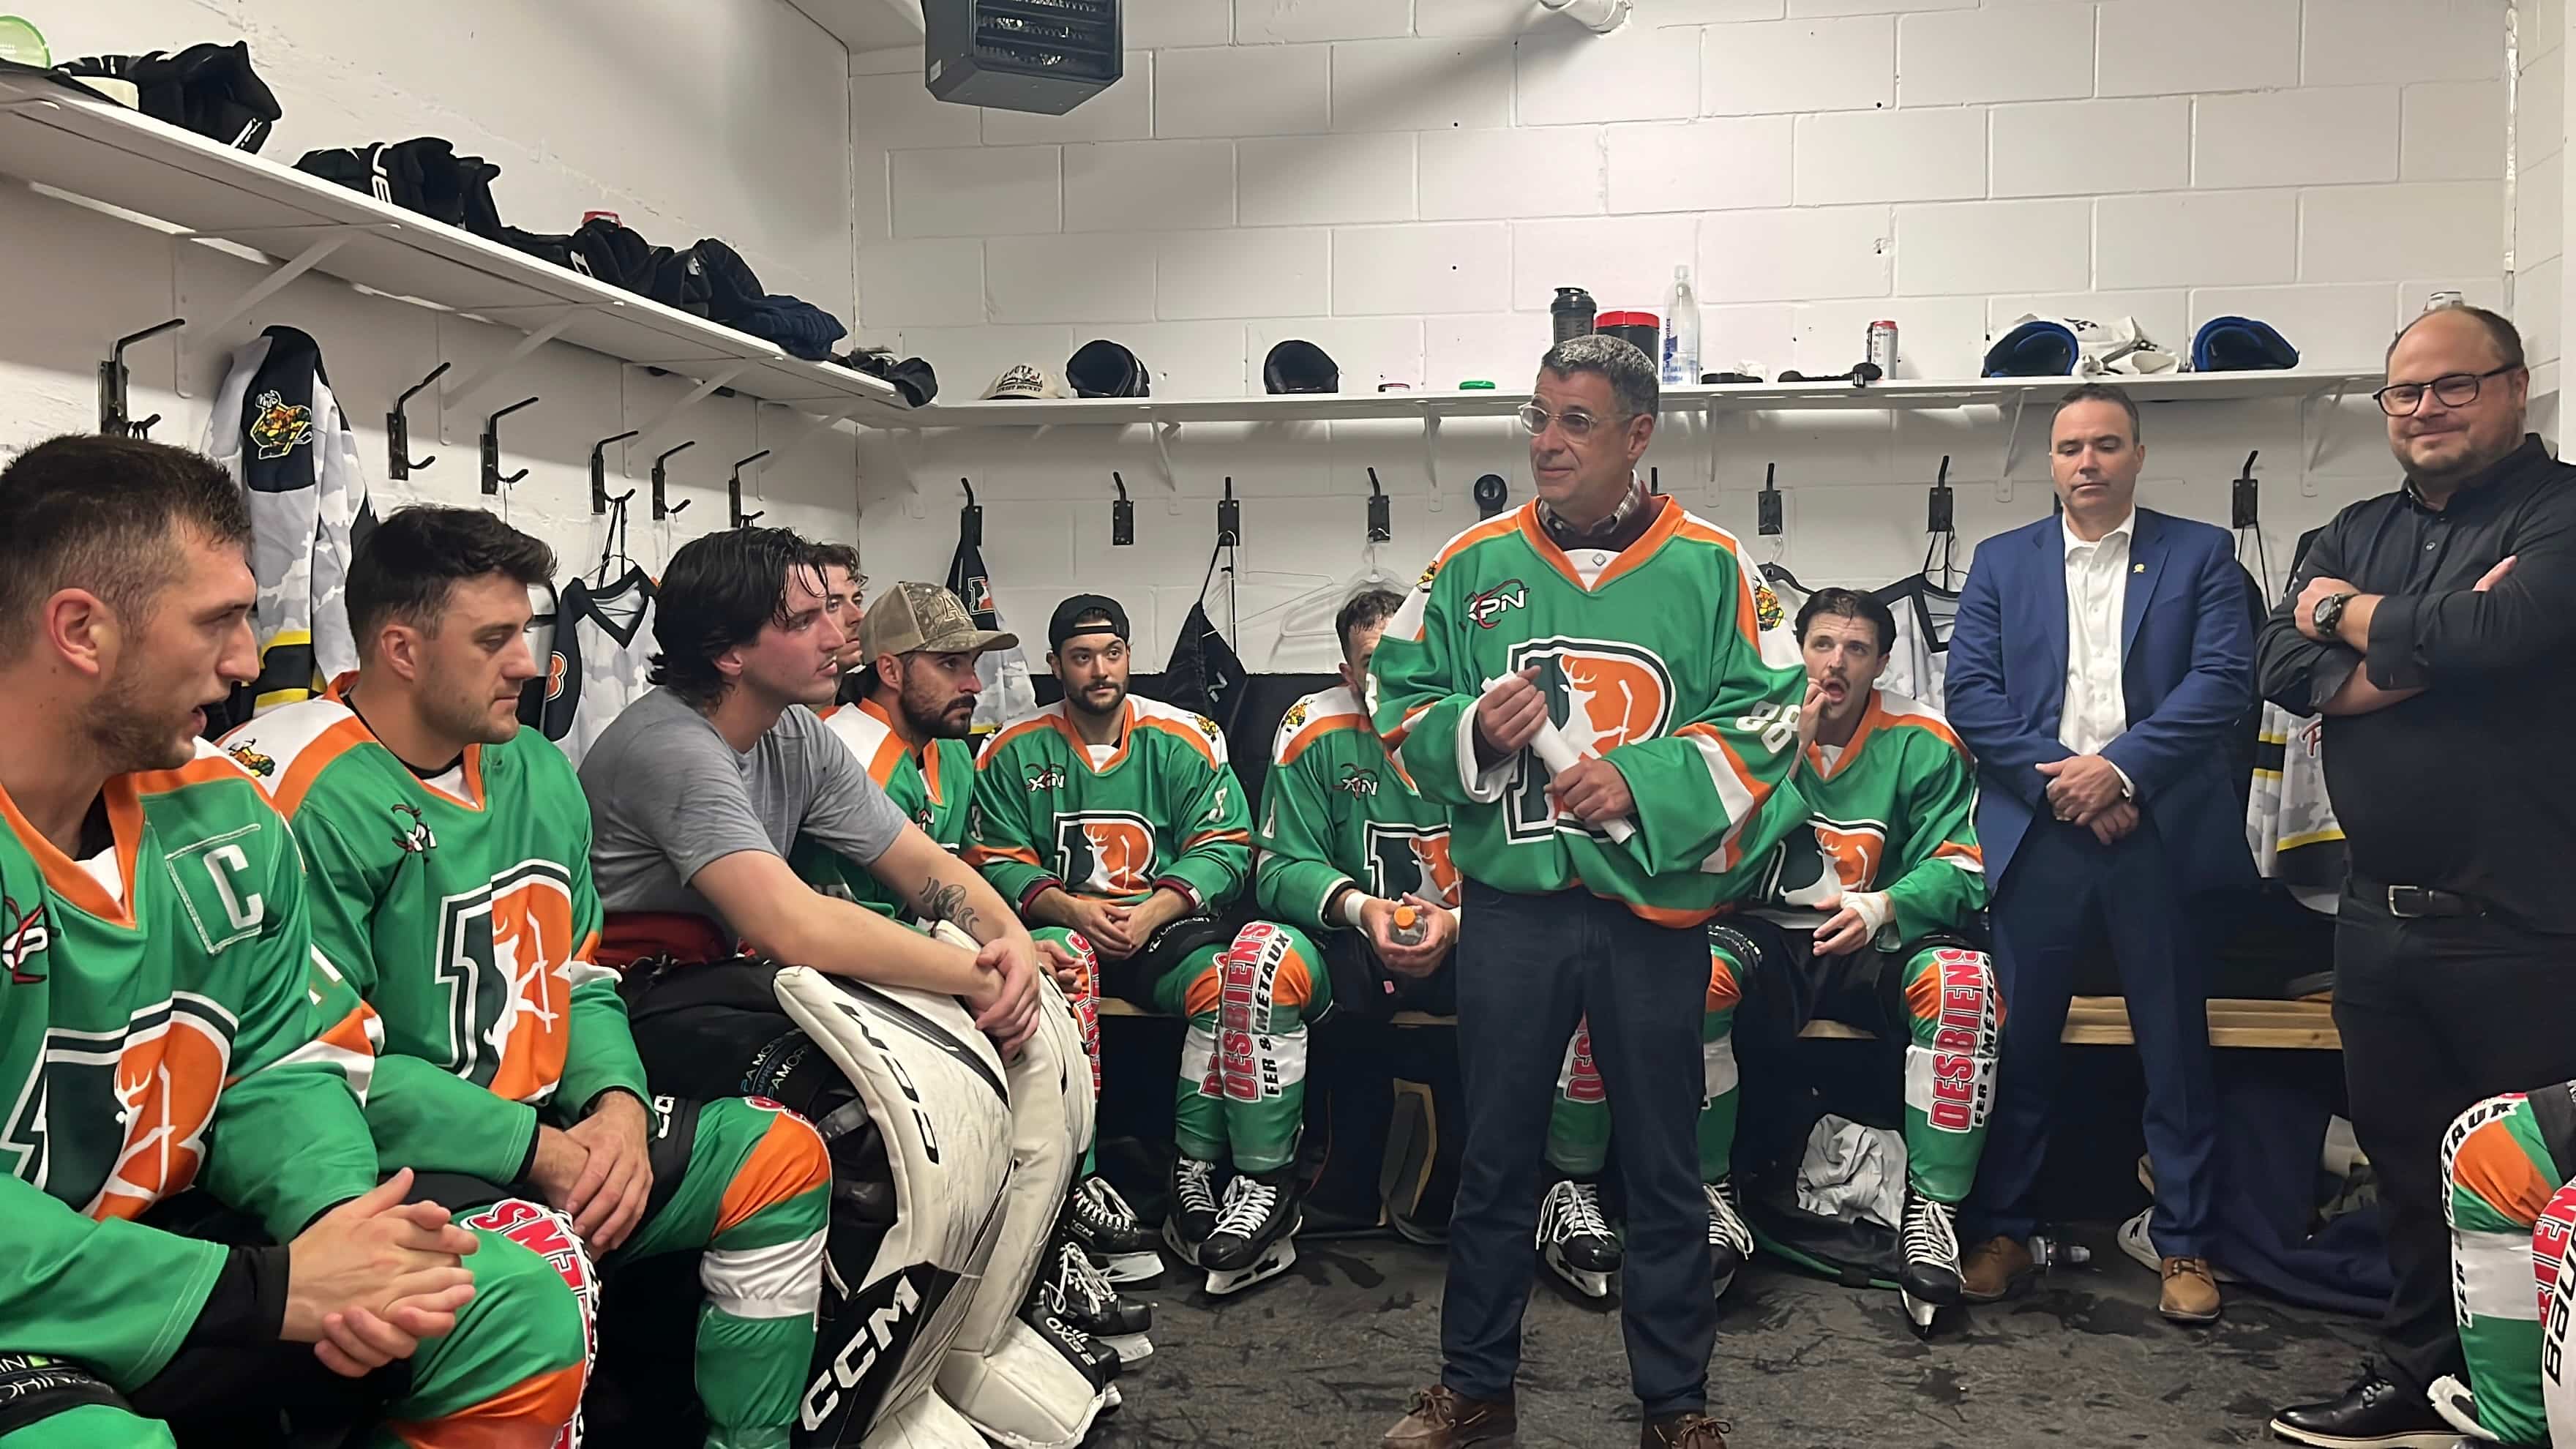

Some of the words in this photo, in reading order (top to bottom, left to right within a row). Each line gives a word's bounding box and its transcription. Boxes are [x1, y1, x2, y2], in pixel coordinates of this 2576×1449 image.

[203, 844, 264, 930] C
[1223, 923, 1273, 1101] DESBIENS
[1255, 932, 1290, 1032] MÉTAUX
[1258, 1037, 1272, 1052] &
[1261, 1058, 1280, 1096] FER
[1930, 950, 1983, 1131] DESBIENS
[1974, 1083, 1988, 1125] FER
[800, 1274, 920, 1431] CCM
